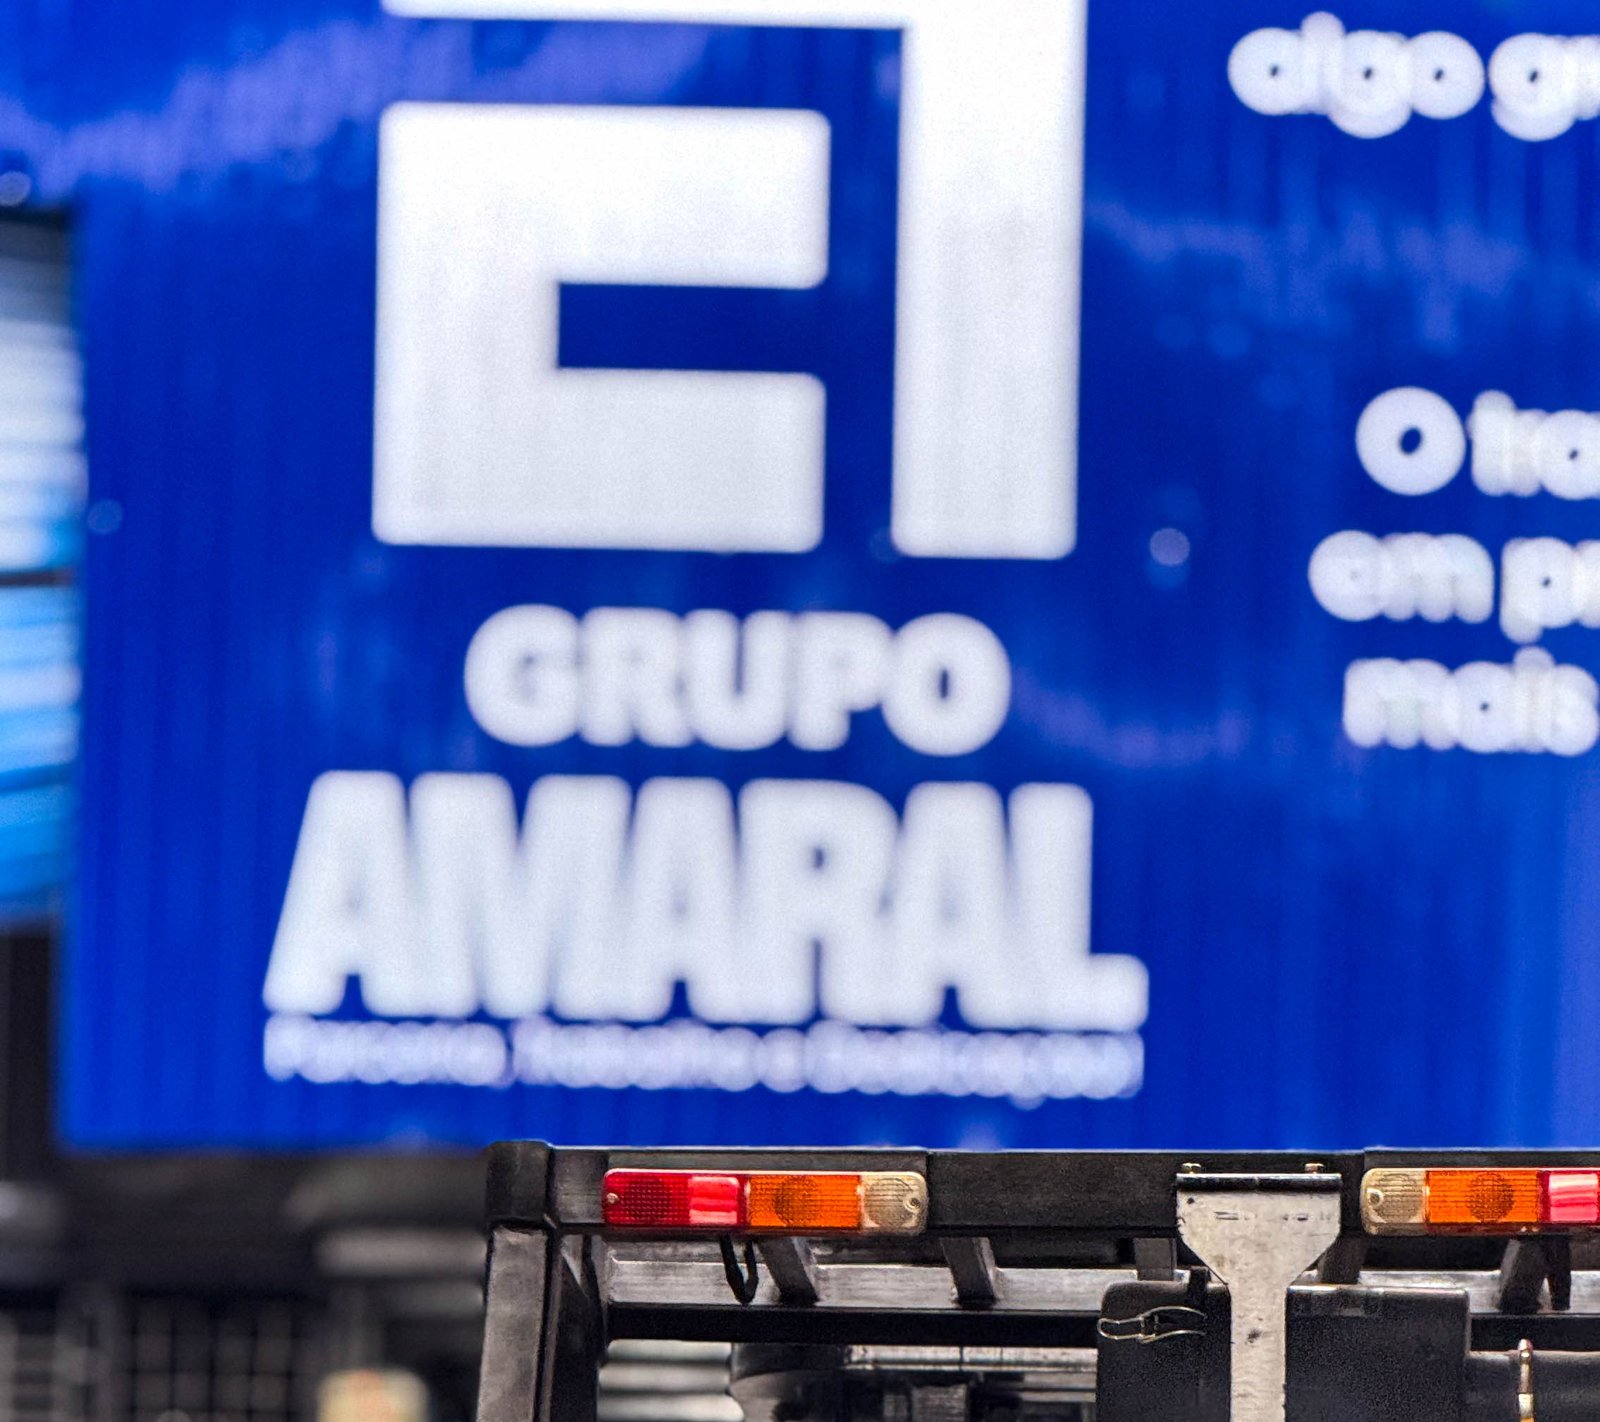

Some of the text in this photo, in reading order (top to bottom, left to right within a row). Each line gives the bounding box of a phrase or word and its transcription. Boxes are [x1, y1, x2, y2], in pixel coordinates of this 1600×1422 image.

[1356, 387, 1466, 495] O
[1309, 531, 1494, 622] em
[465, 604, 1011, 756] GRUPO
[1343, 648, 1599, 756] mais
[264, 770, 1149, 1032] AMARAL
